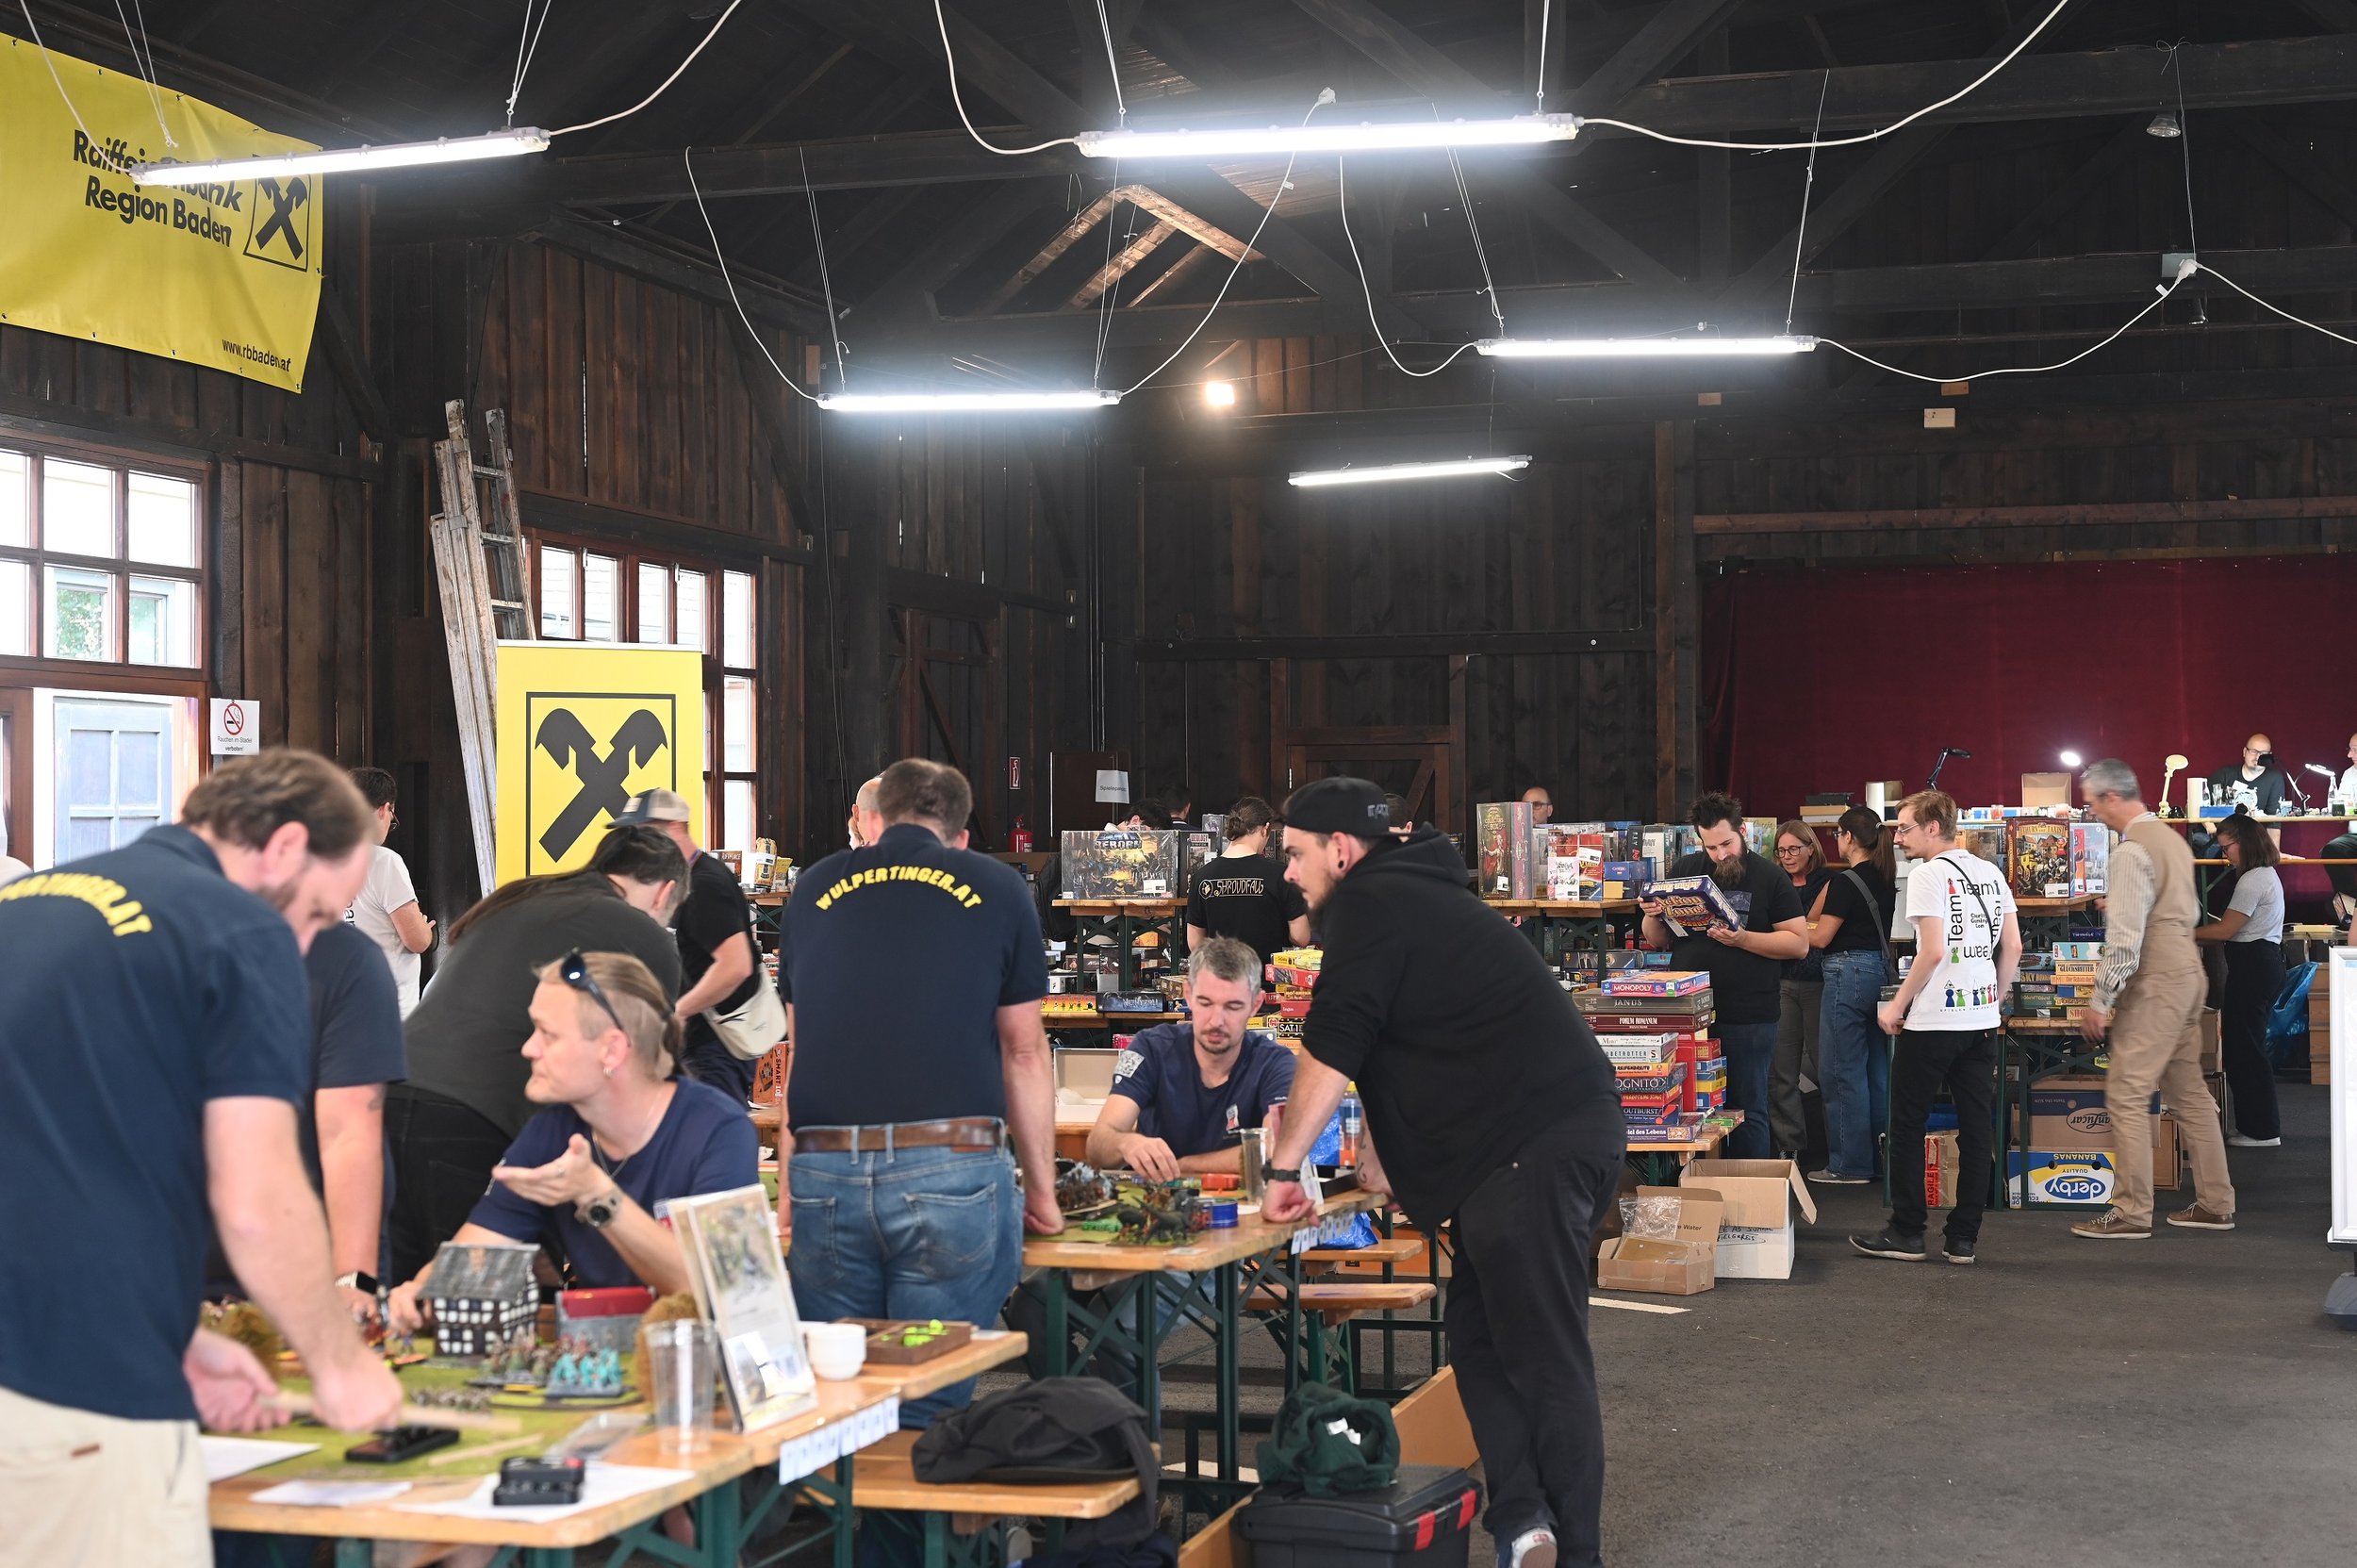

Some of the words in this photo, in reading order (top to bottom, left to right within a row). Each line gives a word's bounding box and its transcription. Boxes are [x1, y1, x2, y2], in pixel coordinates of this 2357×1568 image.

[73, 129, 243, 213] Raiffebank
[85, 175, 168, 224] Region
[173, 198, 232, 247] Baden
[222, 339, 291, 371] www.rbbaden.at
[816, 866, 982, 911] WULPERTINGER.AT
[1956, 879, 1995, 895] Team
[1948, 895, 1963, 946] Team
[1963, 946, 1991, 961] eam
[1613, 983, 1652, 992] MONOPOLY
[1614, 1077, 1659, 1088] OGNITO
[2070, 1113, 2111, 1130] anLucar
[2048, 1177, 2102, 1199] derby
